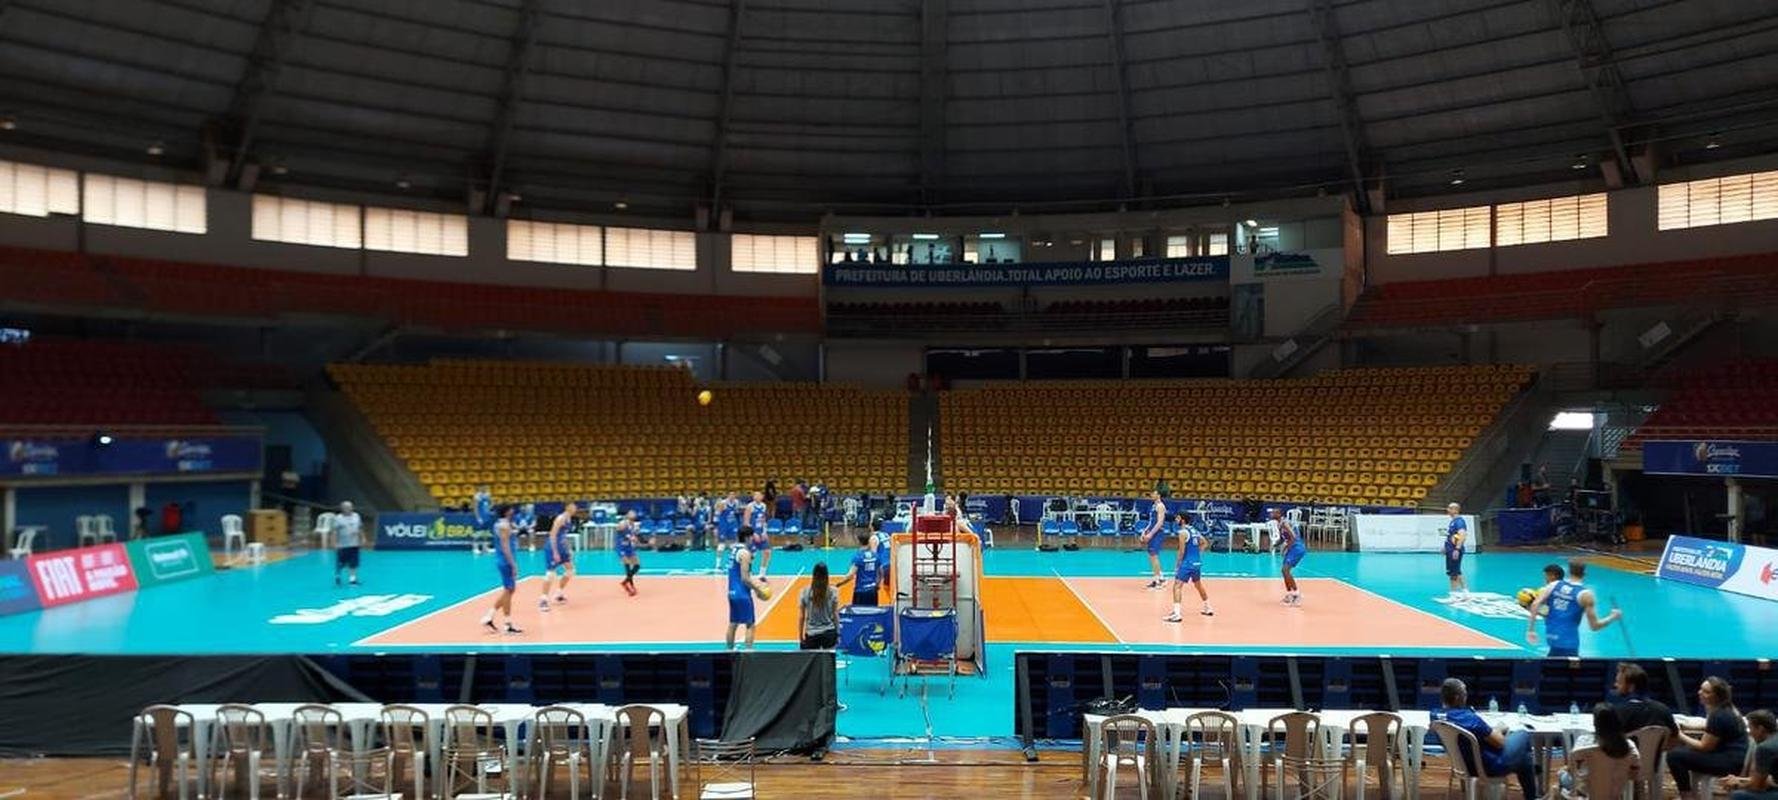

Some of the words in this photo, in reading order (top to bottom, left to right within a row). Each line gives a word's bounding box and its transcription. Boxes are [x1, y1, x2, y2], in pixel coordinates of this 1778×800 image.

[835, 269, 908, 282] PREFEITURA
[910, 271, 927, 282] DE
[1044, 267, 1083, 281] APOIO
[1084, 266, 1102, 279] AO
[1104, 263, 1161, 279] ESPORTE
[1163, 263, 1172, 276] E
[35, 556, 84, 600] FIAT
